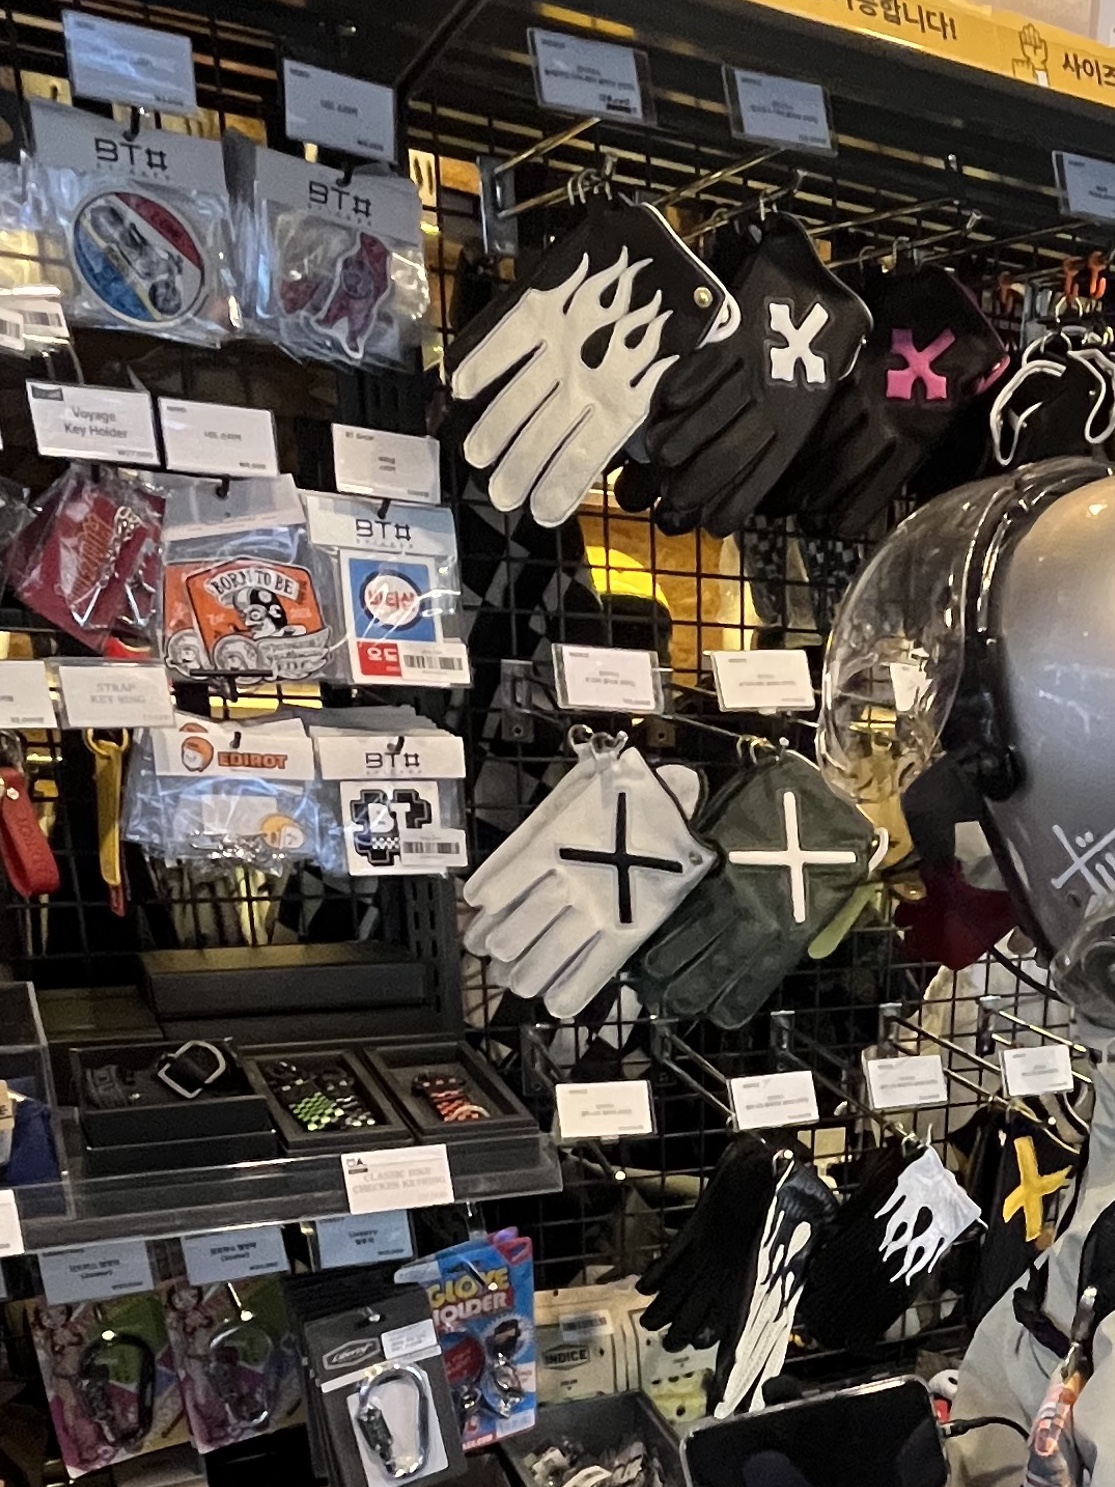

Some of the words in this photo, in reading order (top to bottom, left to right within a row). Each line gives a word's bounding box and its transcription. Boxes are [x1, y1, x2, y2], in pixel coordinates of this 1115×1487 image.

[71, 406, 116, 422] Voyage
[64, 422, 86, 437] Key
[89, 424, 128, 438] Holder
[254, 569, 272, 586] TO
[274, 574, 294, 595] BE
[217, 751, 288, 770] EDIROT
[544, 1348, 588, 1366] INDICE
